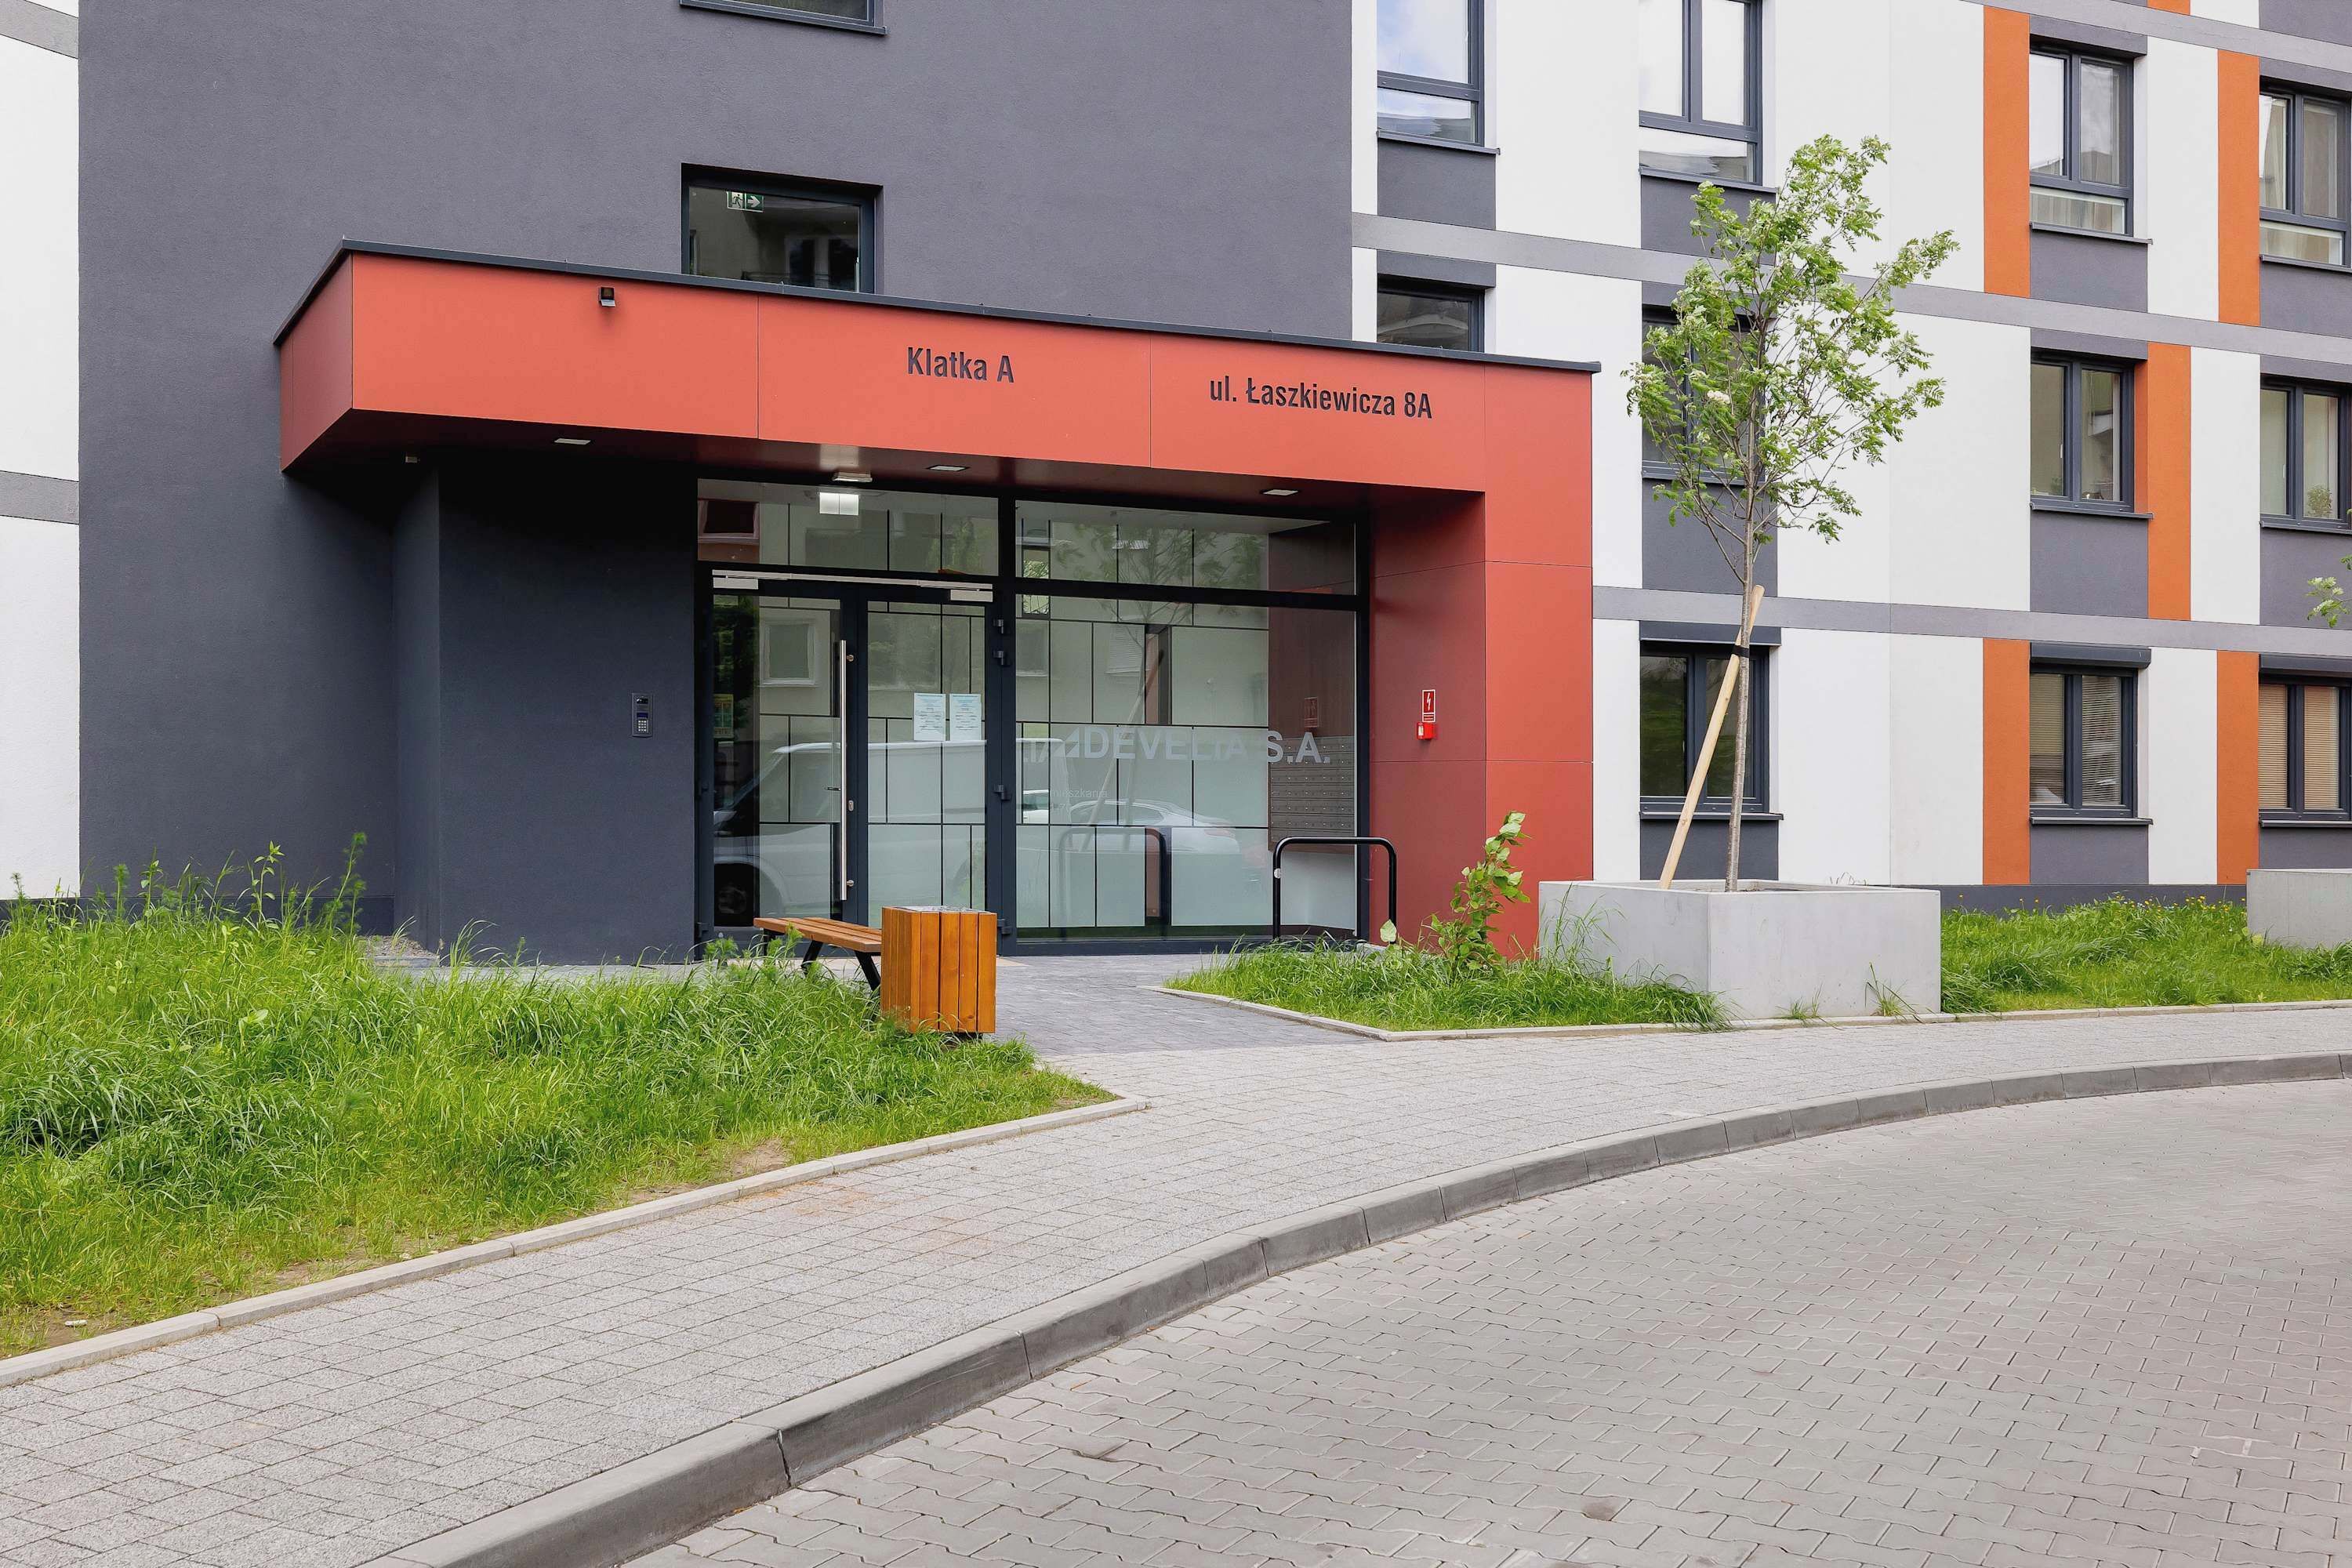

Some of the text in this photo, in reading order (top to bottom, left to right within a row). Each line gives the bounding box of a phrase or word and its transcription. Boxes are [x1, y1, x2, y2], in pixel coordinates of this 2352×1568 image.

[907, 347, 1014, 383] Klatka A
[1210, 376, 1432, 419] ul. Łaszkiewicza 8A
[1265, 730, 1330, 764] S.A.
